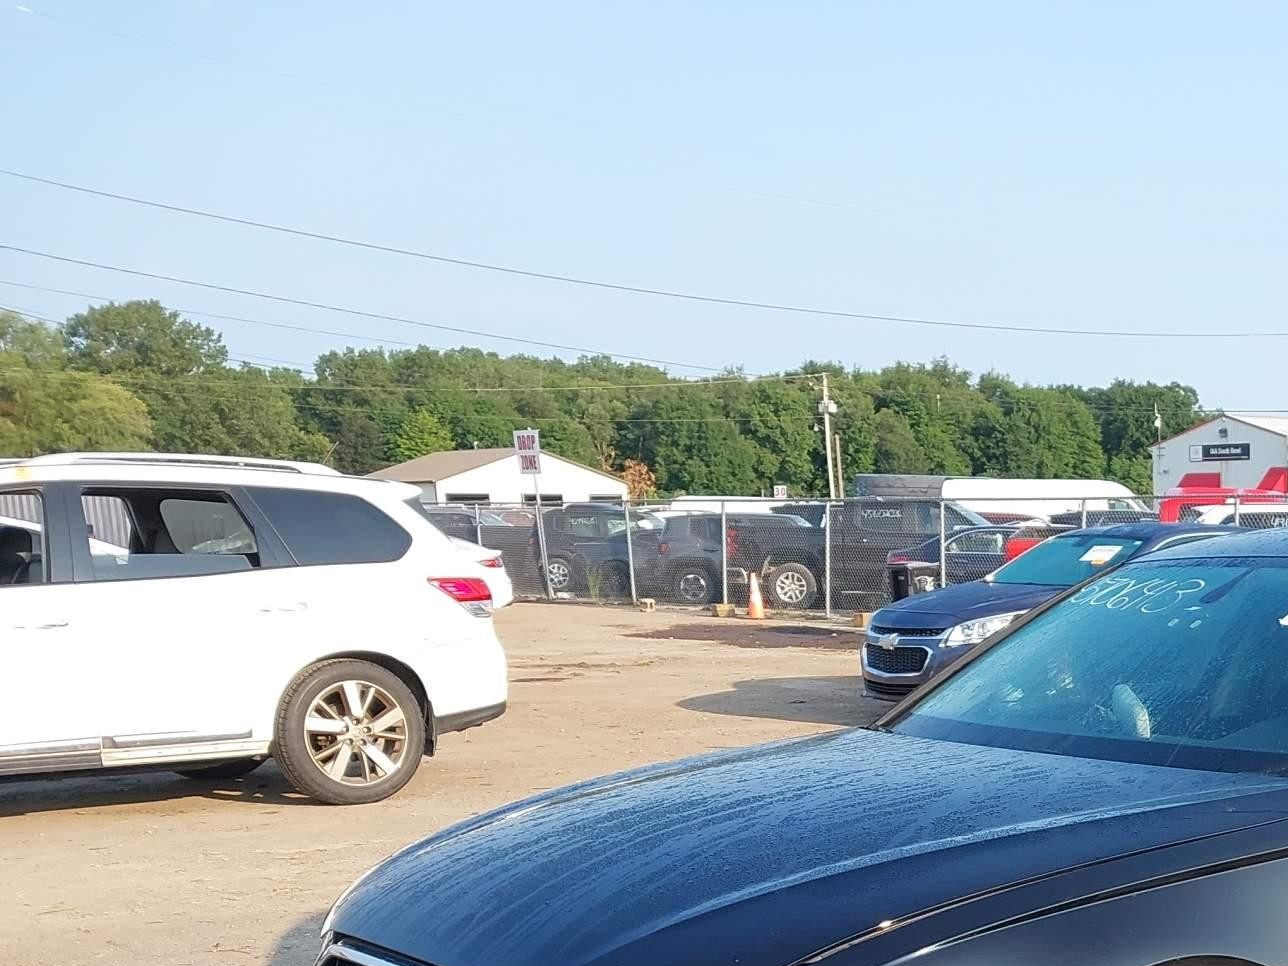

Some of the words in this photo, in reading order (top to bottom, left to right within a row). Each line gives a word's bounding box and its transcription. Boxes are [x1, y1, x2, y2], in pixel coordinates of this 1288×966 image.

[517, 435, 535, 450] DROP
[520, 455, 537, 470] ZONE
[775, 487, 786, 497] 30
